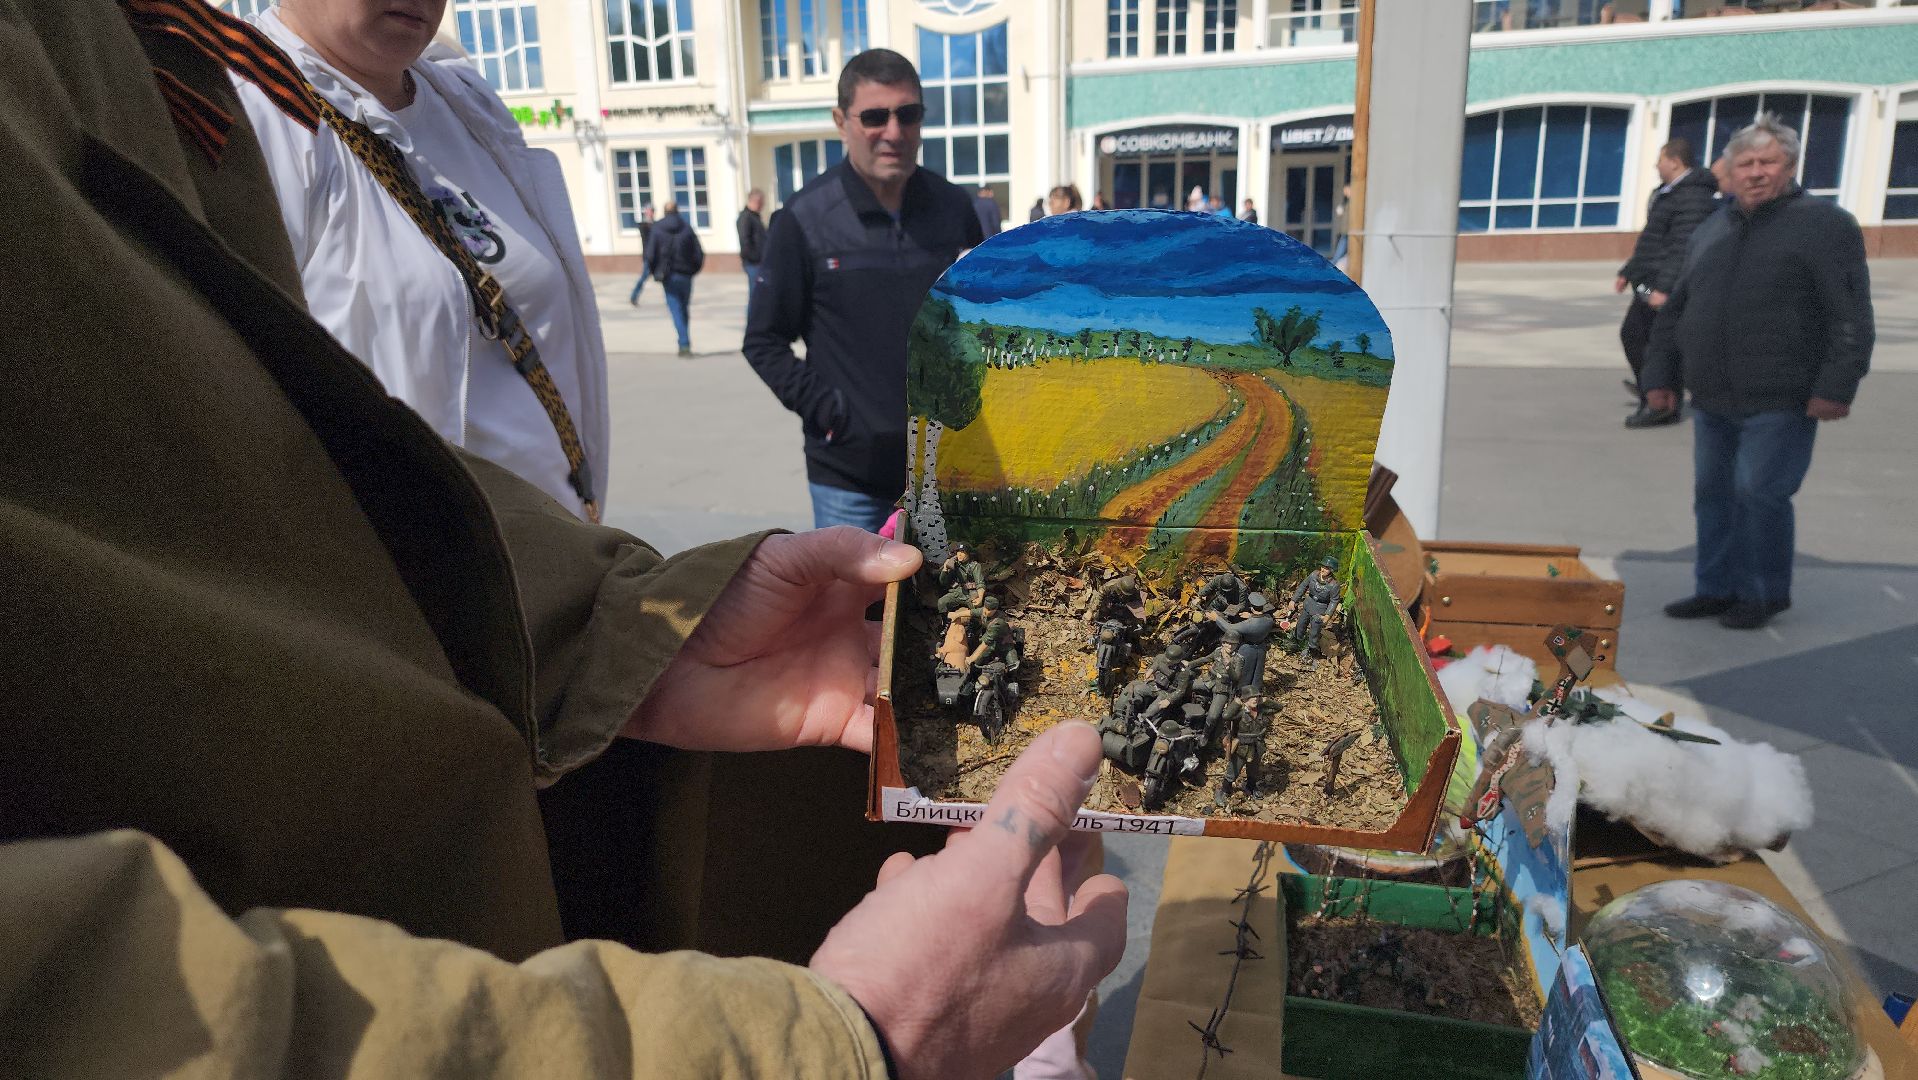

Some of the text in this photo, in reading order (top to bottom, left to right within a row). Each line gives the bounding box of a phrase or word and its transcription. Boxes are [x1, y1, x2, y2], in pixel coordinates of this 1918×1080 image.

[1117, 130, 1233, 152] СОВКОМБАНК
[1281, 128, 1324, 144] ЦВЕТ
[1072, 816, 1104, 829] ль
